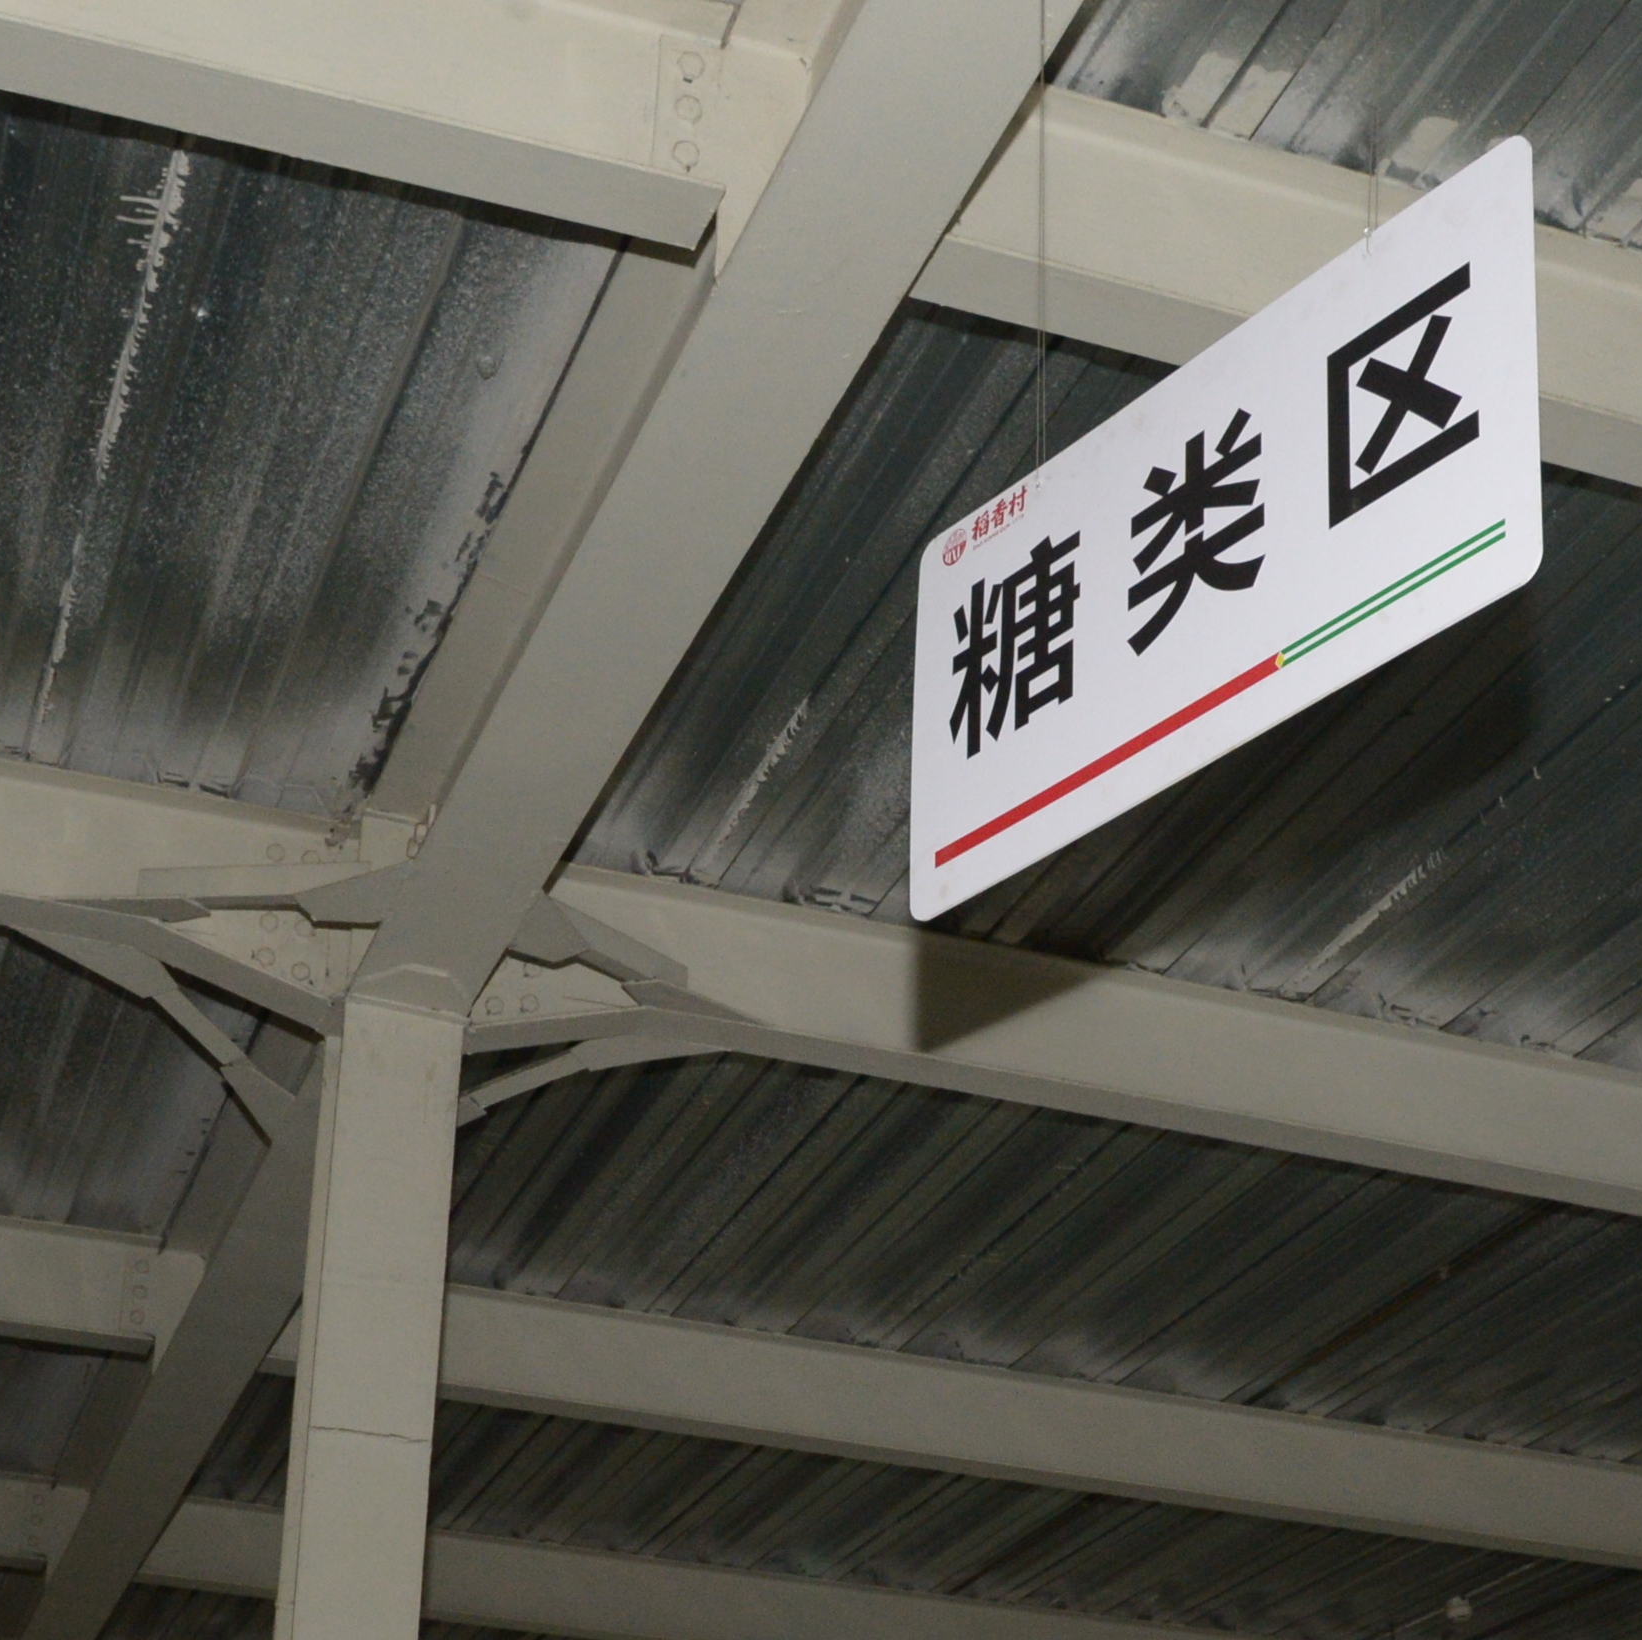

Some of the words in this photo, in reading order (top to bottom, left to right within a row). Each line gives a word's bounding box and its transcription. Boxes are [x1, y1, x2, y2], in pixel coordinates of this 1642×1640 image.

[948, 261, 1480, 760] 糖类区
[971, 485, 1028, 542] 稻香村
